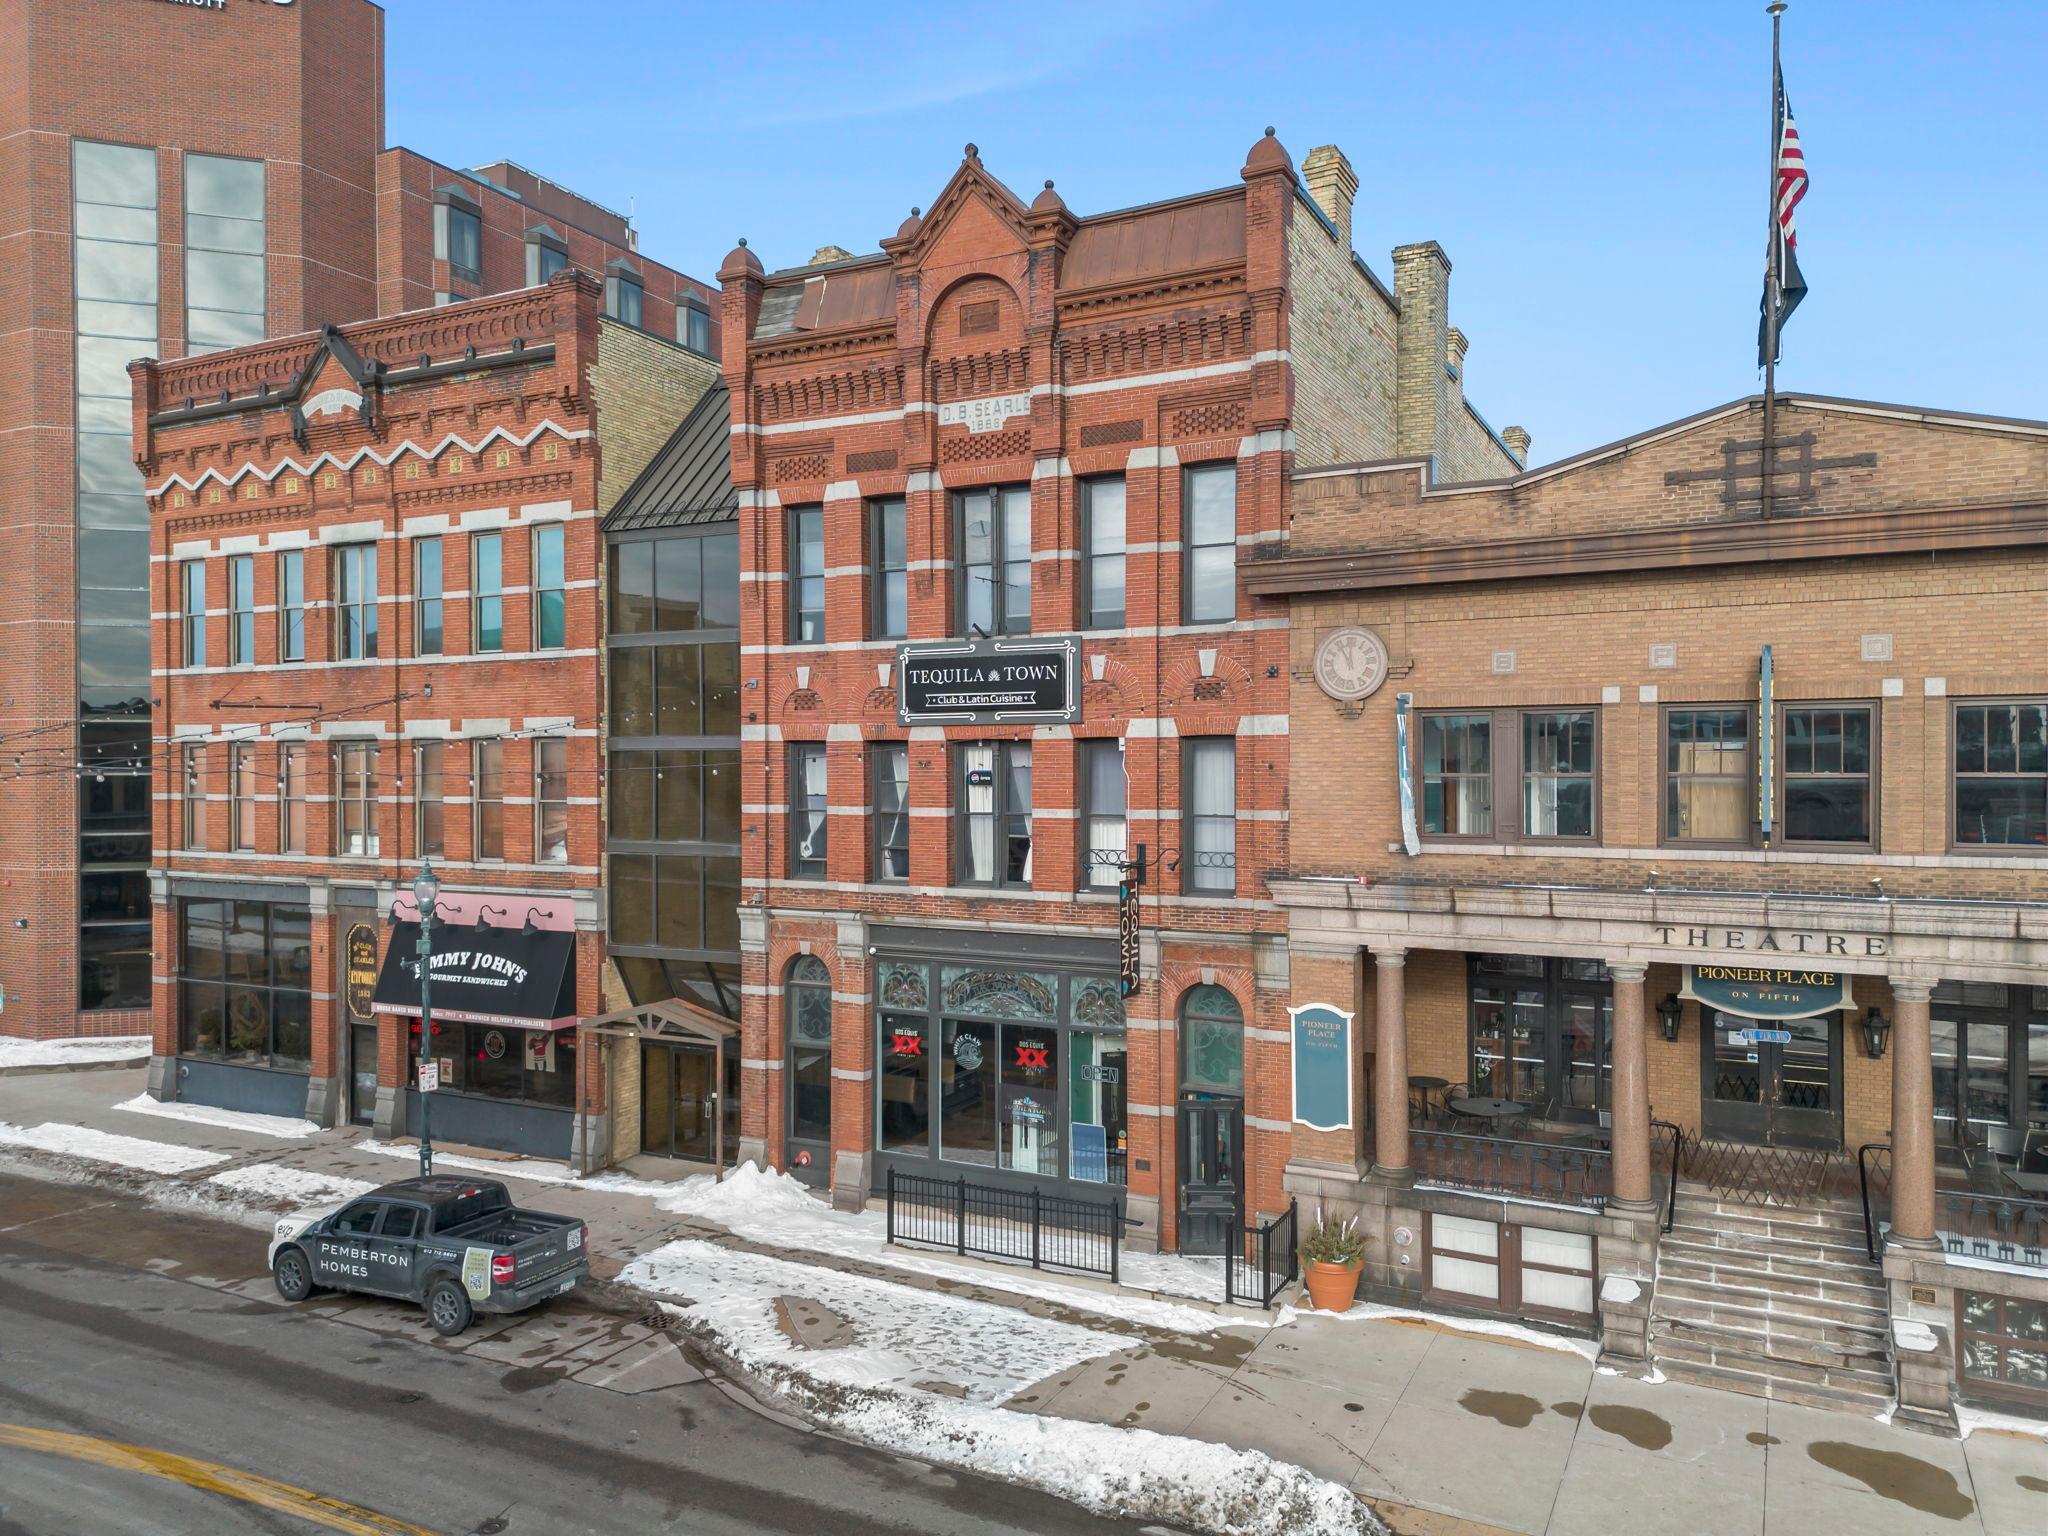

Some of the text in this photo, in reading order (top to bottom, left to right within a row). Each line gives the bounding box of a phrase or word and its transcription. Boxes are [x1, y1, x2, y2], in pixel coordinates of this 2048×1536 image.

[975, 396, 1030, 417] SEARLE
[909, 665, 1058, 685] TEQUILA TOWN
[937, 693, 1023, 704] Club & Latin Cuisine
[1121, 900, 1130, 976] TOWN
[1130, 881, 1139, 990] TEQUILA
[1656, 927, 1887, 956] THEATRE
[472, 952, 528, 984] JOHN'S
[1698, 966, 1835, 986] PIONEER PLACE
[462, 976, 508, 987] SANDWICHES
[1759, 993, 1800, 1002] FIFTH
[466, 1013, 545, 1027] SANDWICH DELIVERY SPECIALISTS
[1302, 1020, 1341, 1031] PIONEER
[953, 1033, 982, 1056] WHITE CLAW
[1308, 1030, 1336, 1039] PLACE
[891, 1035, 922, 1055] XX
[1015, 1047, 1049, 1069] XX
[1083, 1066, 1117, 1082] OPEN
[321, 1243, 408, 1267] PEMBERTON
[320, 1260, 368, 1277] HOMES
